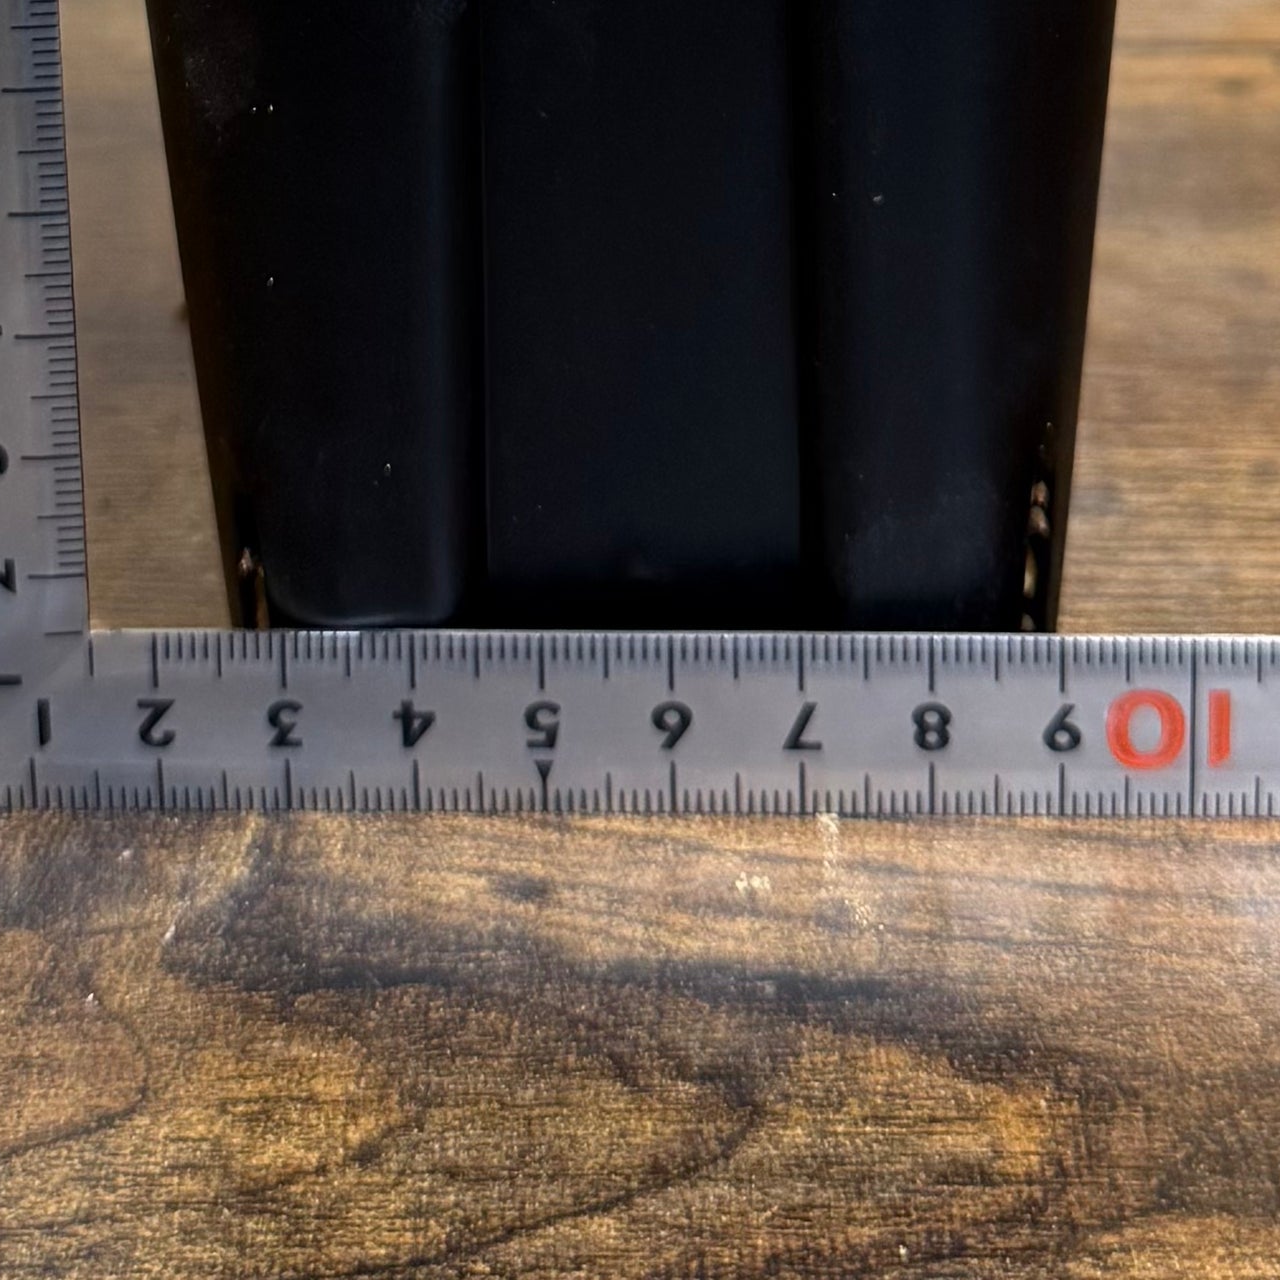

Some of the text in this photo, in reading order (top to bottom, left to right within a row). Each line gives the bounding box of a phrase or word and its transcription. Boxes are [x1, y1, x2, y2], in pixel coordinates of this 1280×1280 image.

[38, 701, 50, 747] 1
[138, 701, 174, 747] 2
[268, 702, 301, 748] 3
[394, 702, 434, 748] 4
[525, 702, 559, 750] 5
[652, 703, 691, 750] 6
[784, 705, 821, 751] 7
[913, 705, 951, 751] 8
[1044, 706, 1081, 752] 9
[1107, 691, 1231, 771] 10
